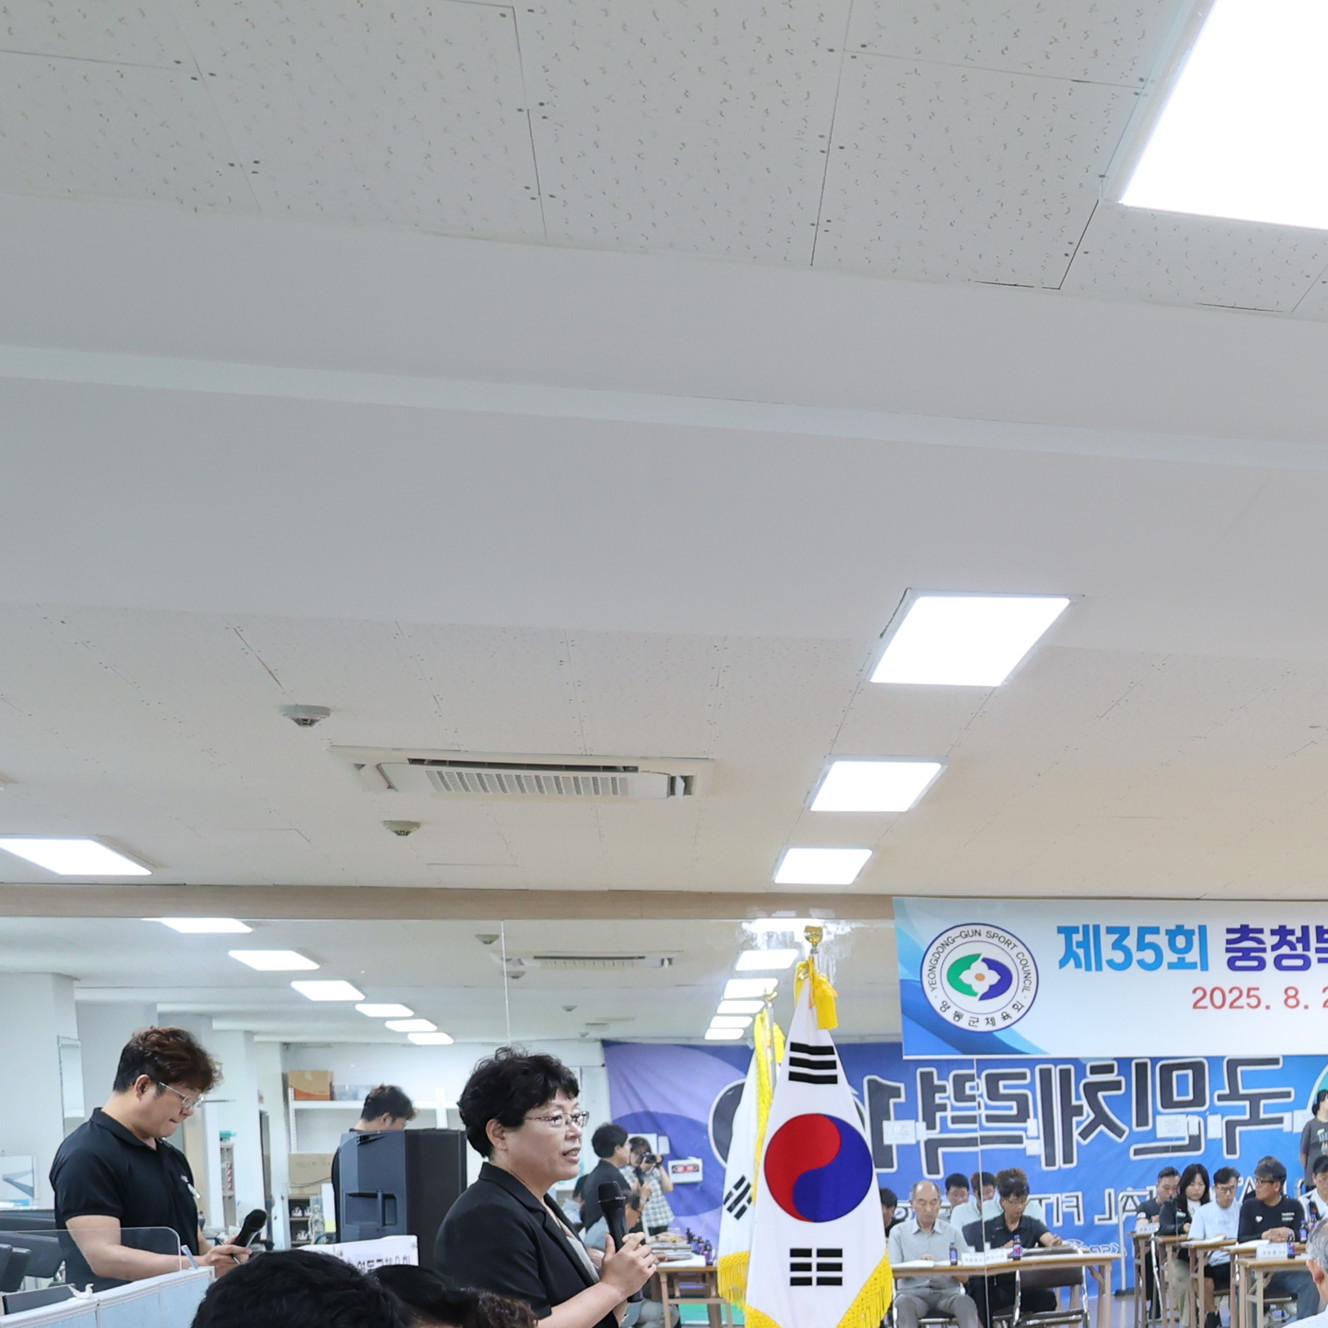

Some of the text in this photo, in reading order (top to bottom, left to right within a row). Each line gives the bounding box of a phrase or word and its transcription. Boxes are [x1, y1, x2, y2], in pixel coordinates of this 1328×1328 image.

[927, 929, 1033, 993] YEONGDONG-GUN SPORT COUNCIL
[1056, 924, 1209, 971] 제35회
[1191, 986, 1271, 1010] 2025.
[1283, 986, 1309, 1010] 8.
